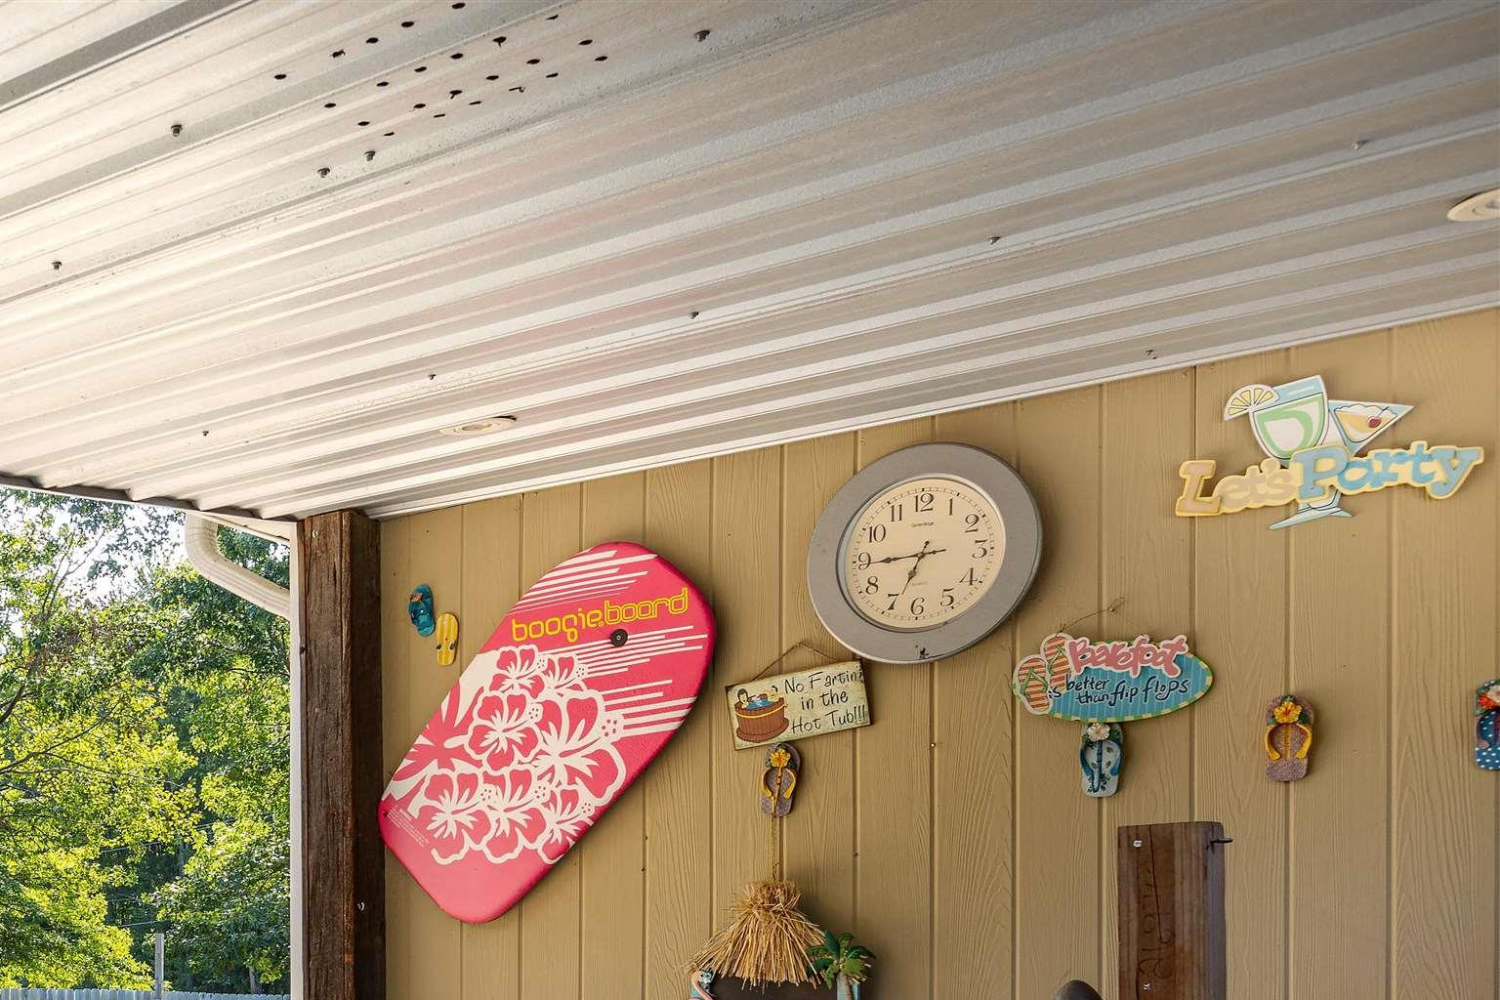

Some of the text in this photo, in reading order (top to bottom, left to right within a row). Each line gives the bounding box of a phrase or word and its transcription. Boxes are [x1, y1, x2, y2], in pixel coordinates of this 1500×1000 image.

[1176, 441, 1484, 516] Let's Party
[914, 492, 935, 512] 12
[948, 498, 954, 516] 1
[889, 504, 903, 522] 11
[964, 513, 981, 533] 2
[868, 524, 887, 543] 10
[971, 539, 988, 559] 3
[857, 552, 872, 571] 9
[865, 575, 879, 595] 8
[958, 567, 978, 586] 4
[887, 593, 900, 611] 7
[910, 597, 925, 616] 6
[939, 588, 955, 607] 5
[1067, 636, 1189, 677] Barefoot
[784, 678, 805, 695] No
[1048, 673, 1110, 699] is better
[1075, 676, 1189, 707] than flip flops
[801, 689, 849, 711] in the
[791, 704, 867, 735] Hot Tub!!!
